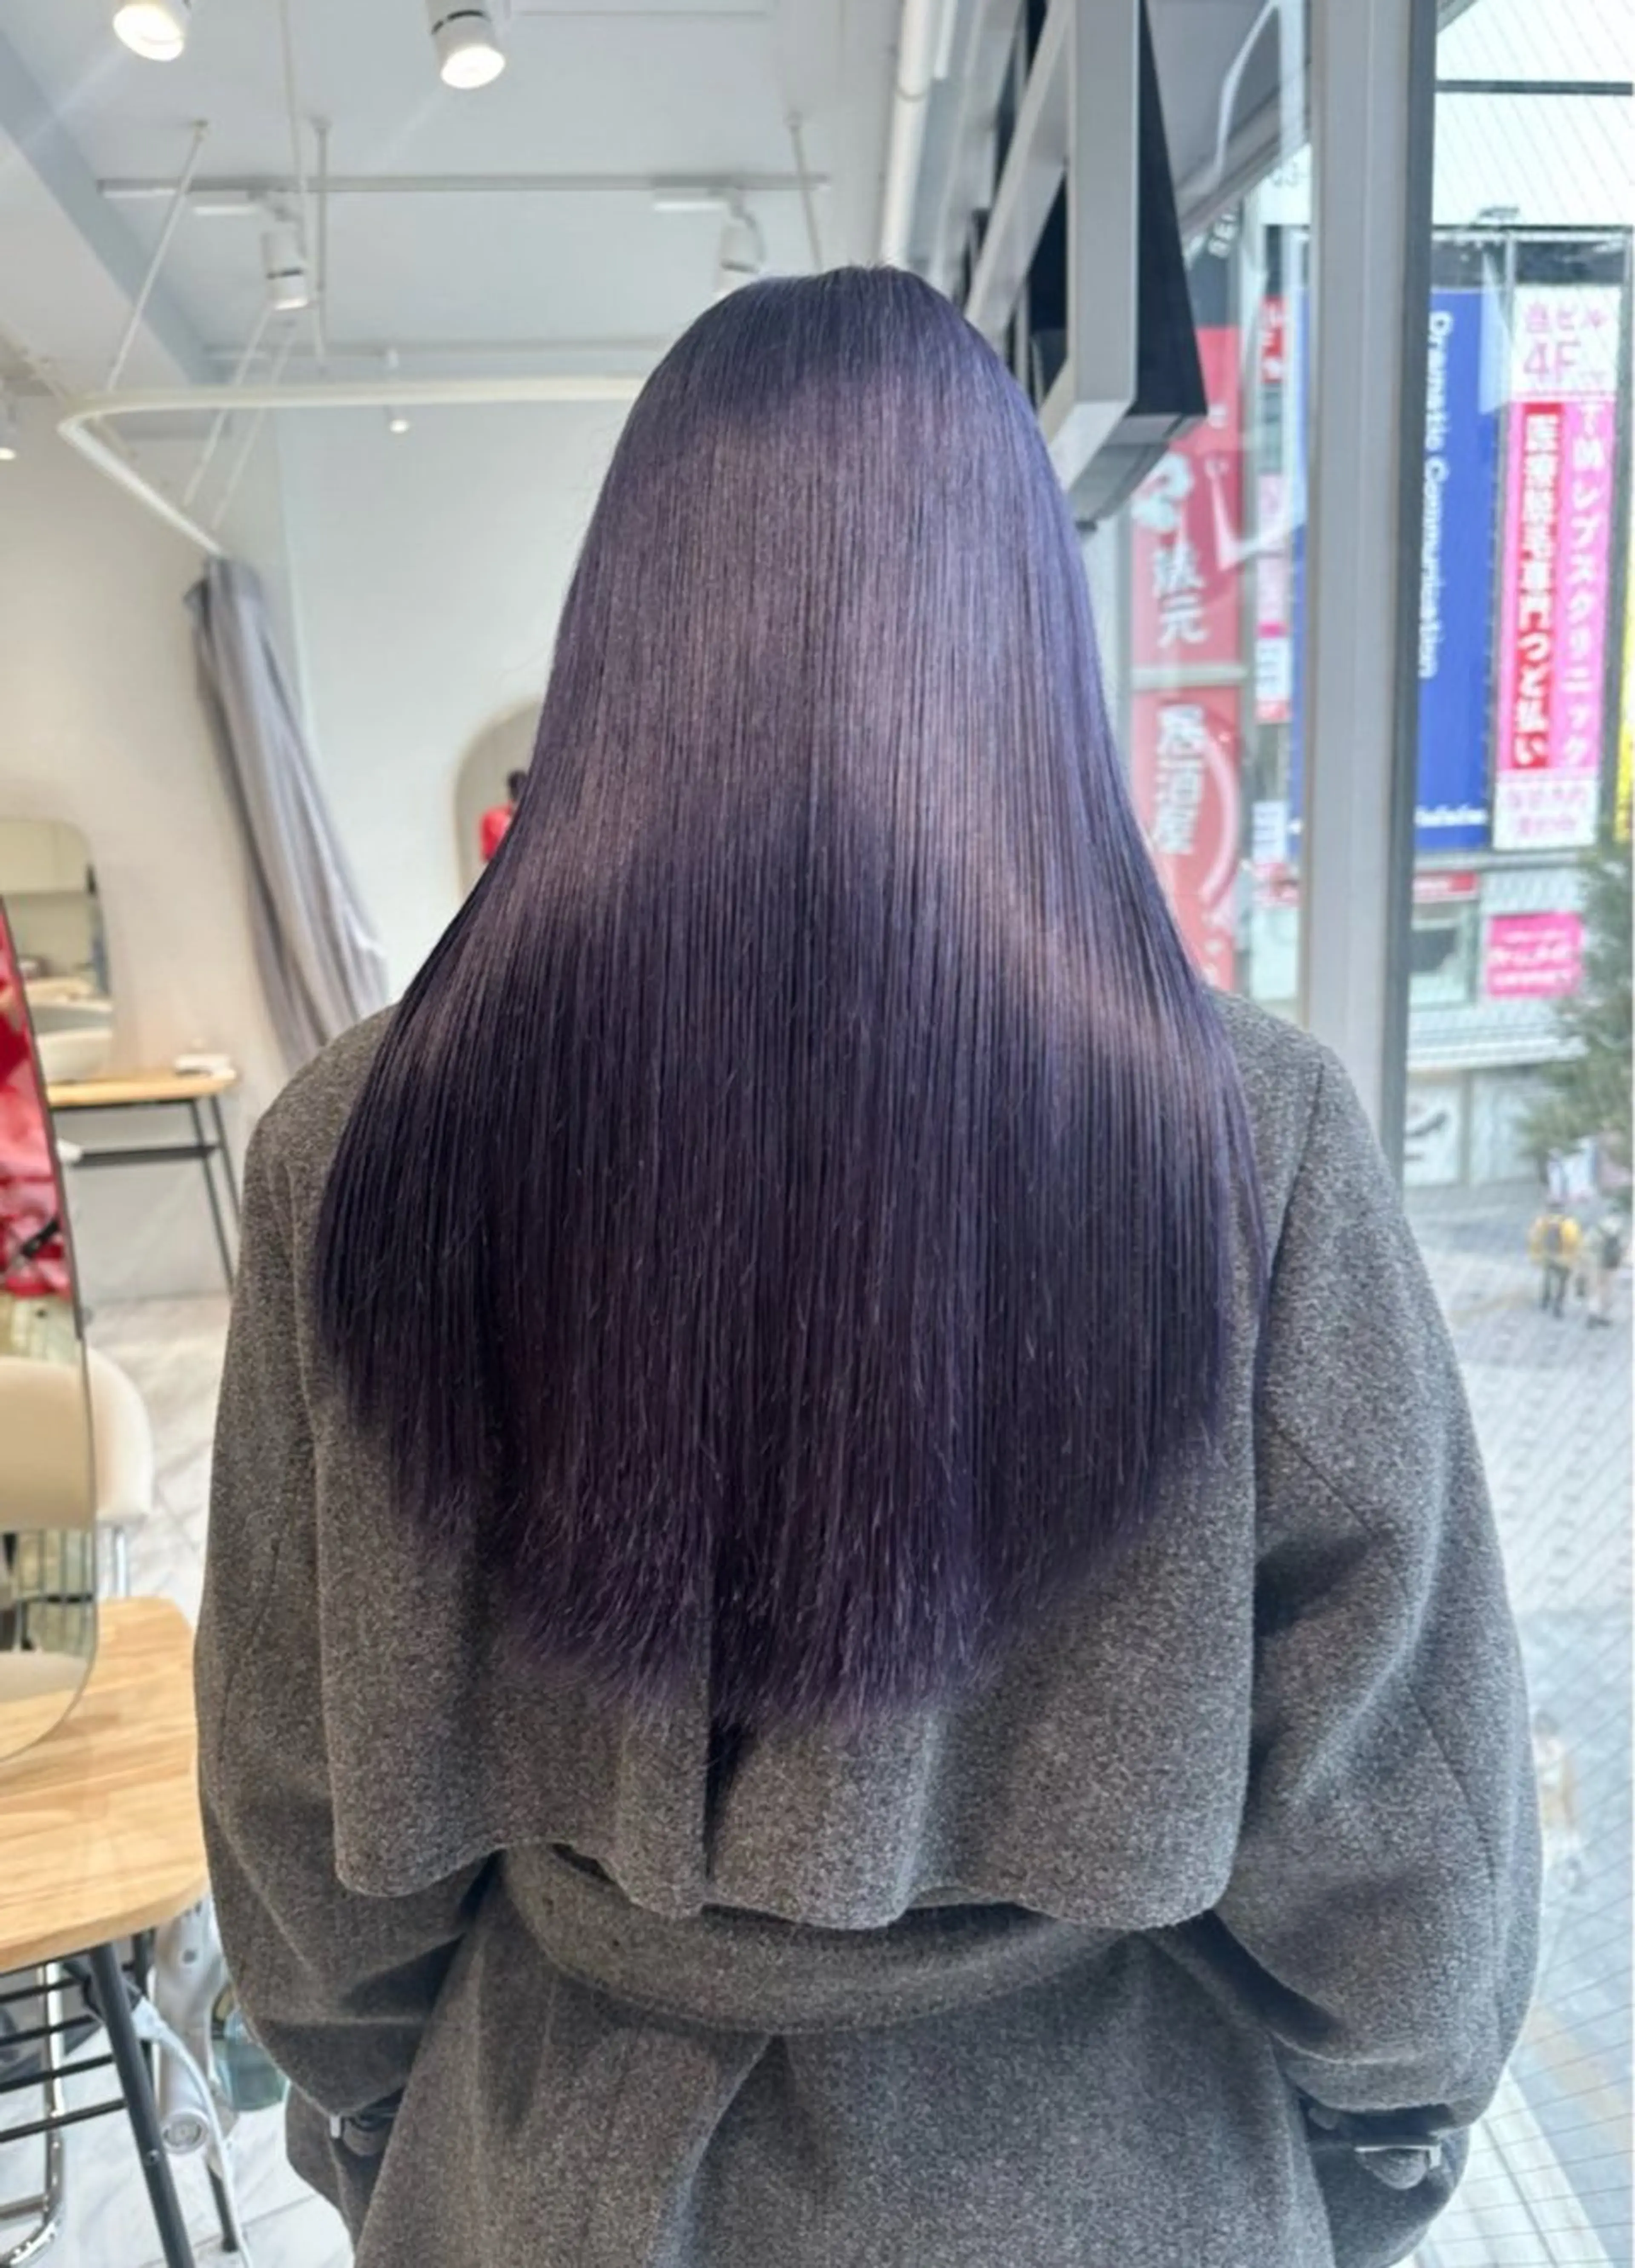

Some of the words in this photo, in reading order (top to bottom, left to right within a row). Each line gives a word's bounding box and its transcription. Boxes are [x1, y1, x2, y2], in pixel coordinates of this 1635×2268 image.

[1425, 311, 1454, 453] Dramatic
[1523, 340, 1581, 383] 4F
[1418, 456, 1449, 679] Communication
